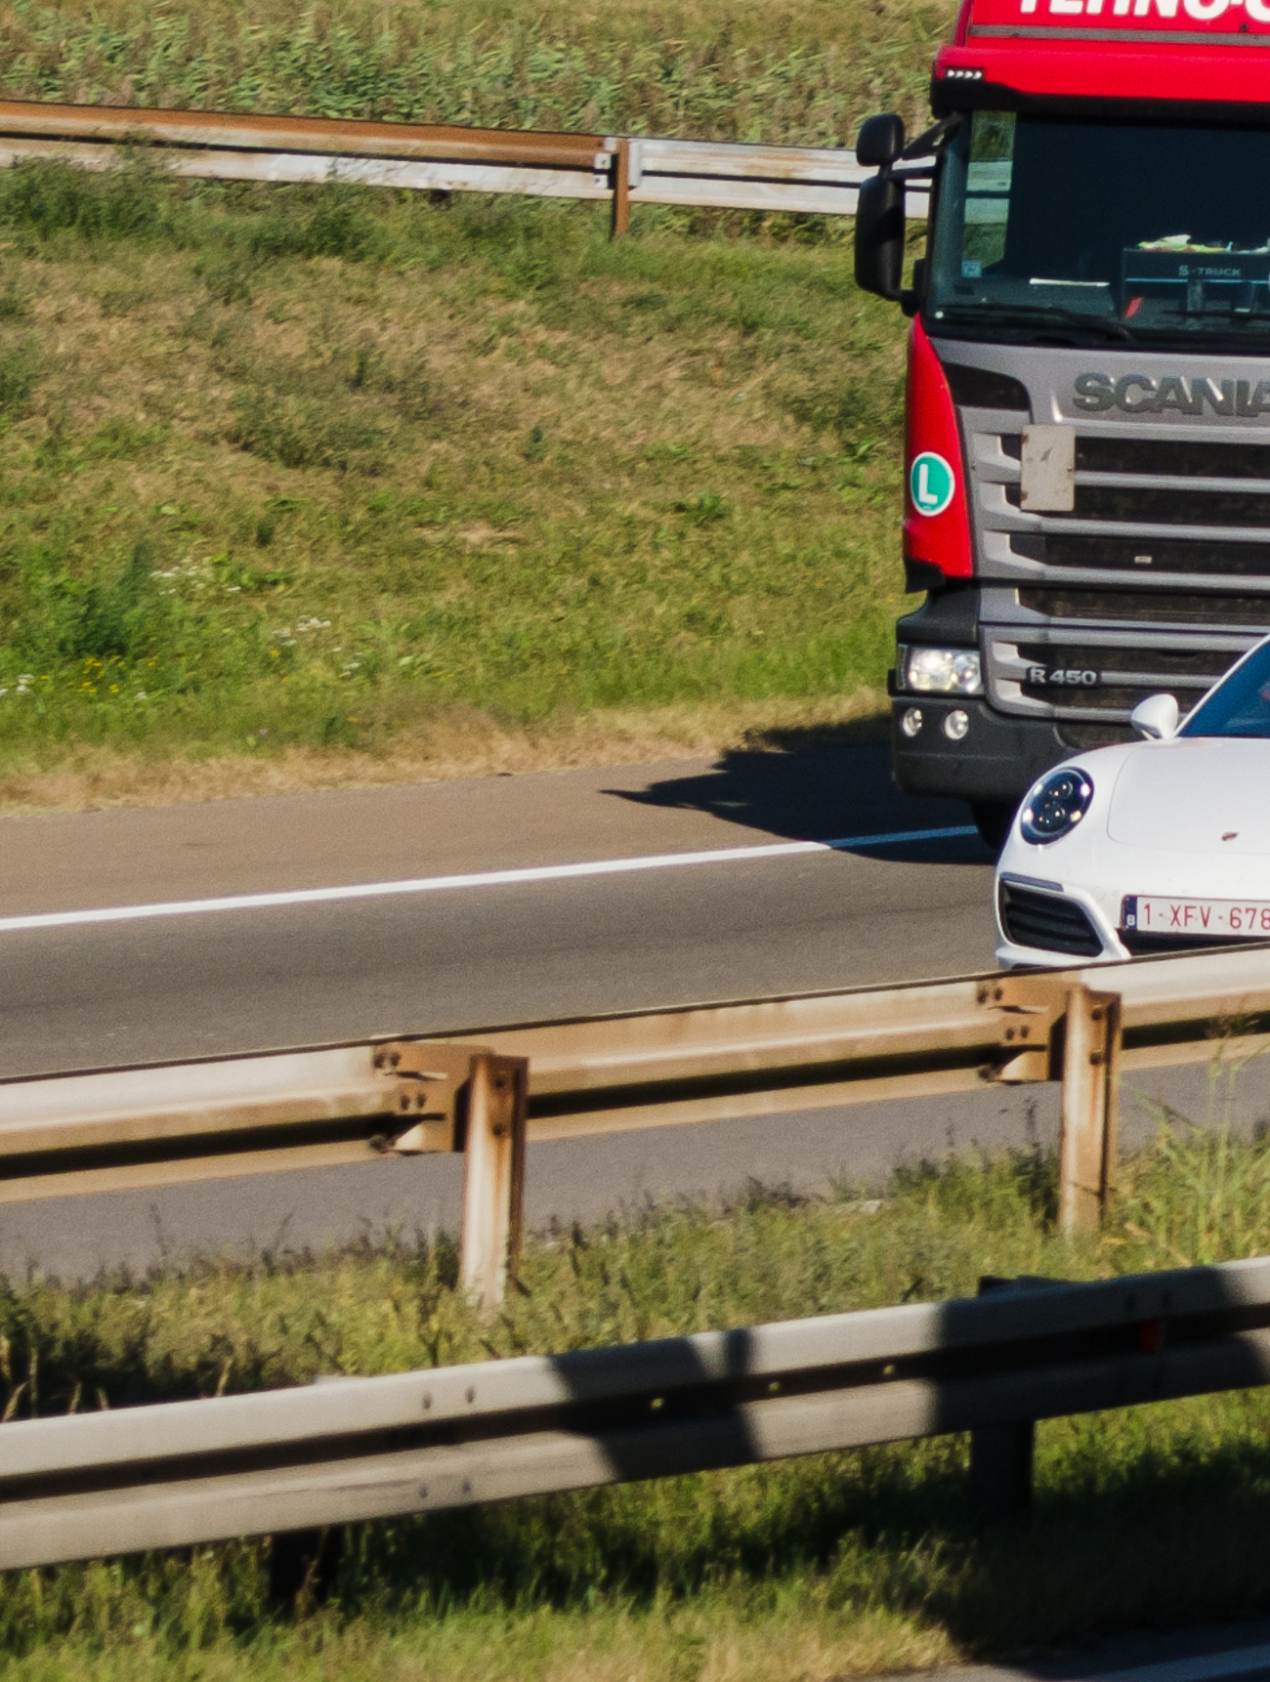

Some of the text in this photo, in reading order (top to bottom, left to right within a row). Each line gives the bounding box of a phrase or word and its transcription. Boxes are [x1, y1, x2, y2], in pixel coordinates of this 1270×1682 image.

[918, 463, 938, 505] L
[1030, 668, 1097, 686] R 450
